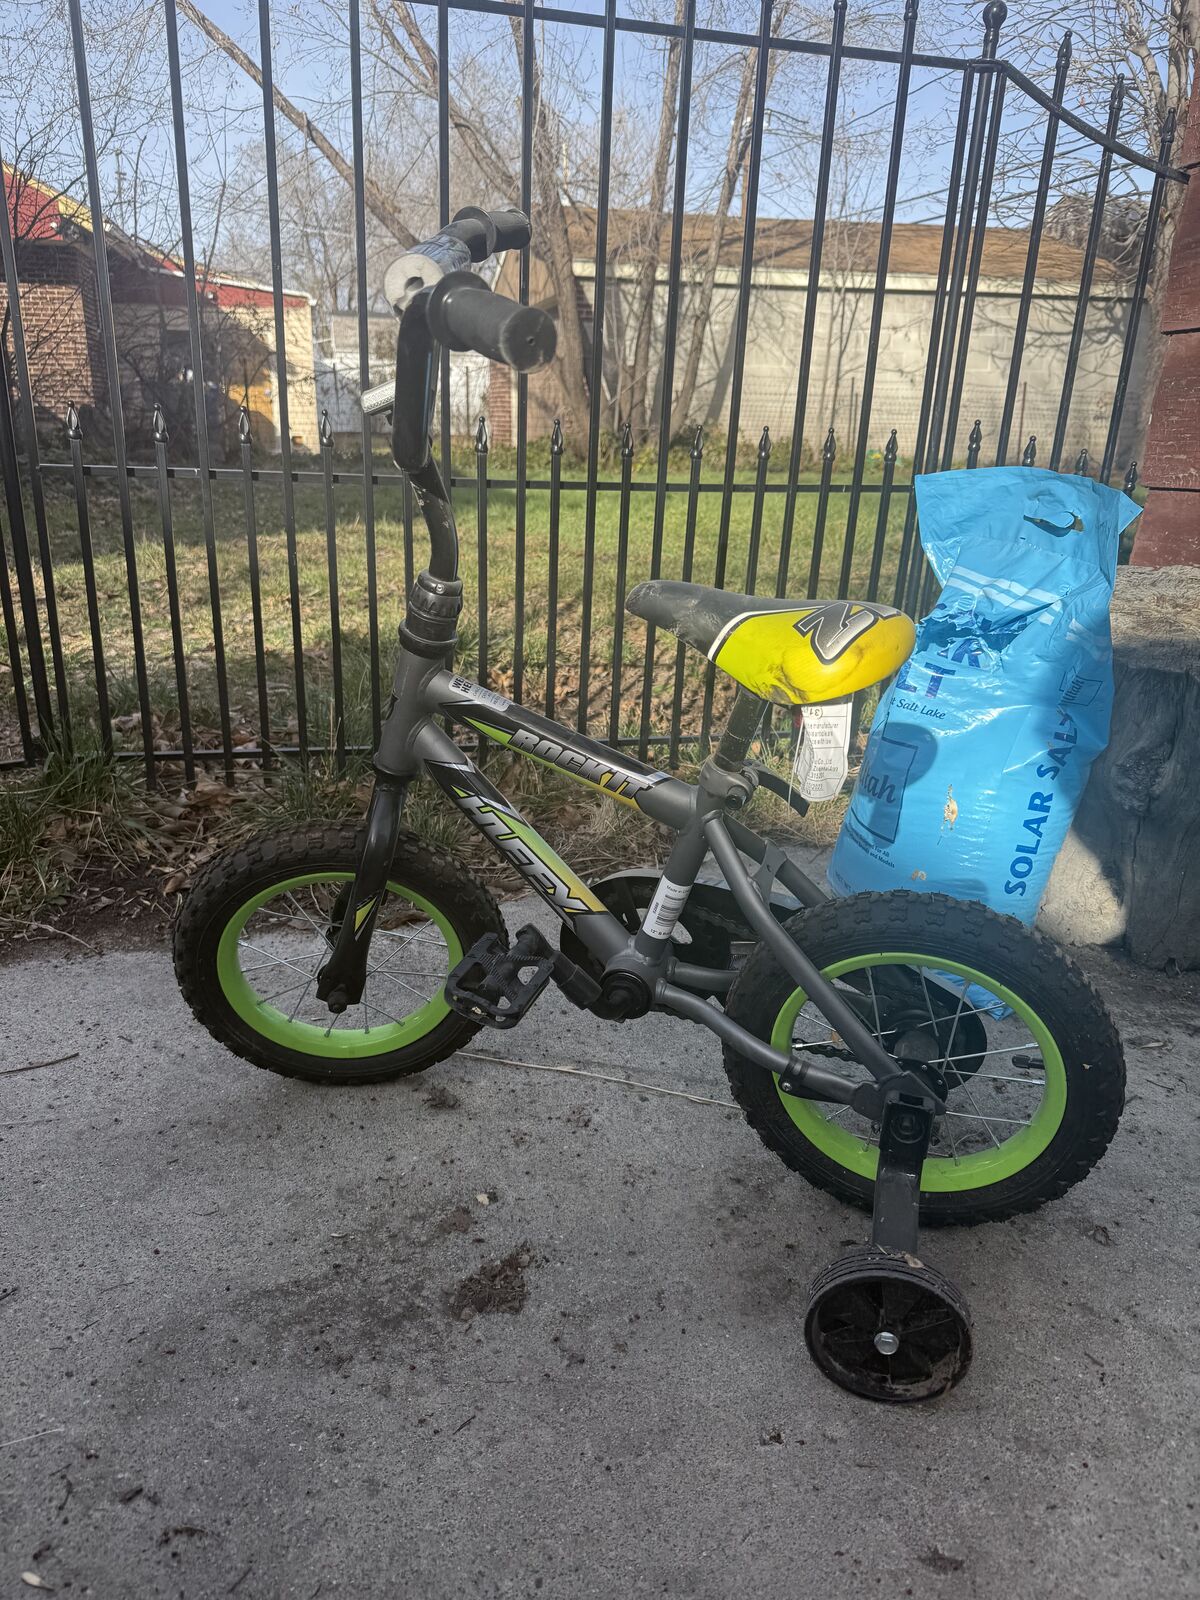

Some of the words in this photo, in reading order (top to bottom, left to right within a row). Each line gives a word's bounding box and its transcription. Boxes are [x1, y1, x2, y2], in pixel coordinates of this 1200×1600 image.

[897, 698, 919, 712] Salt
[920, 705, 946, 720] Lake
[456, 794, 591, 912] HUFFY
[1004, 791, 1054, 897] SOLAR
